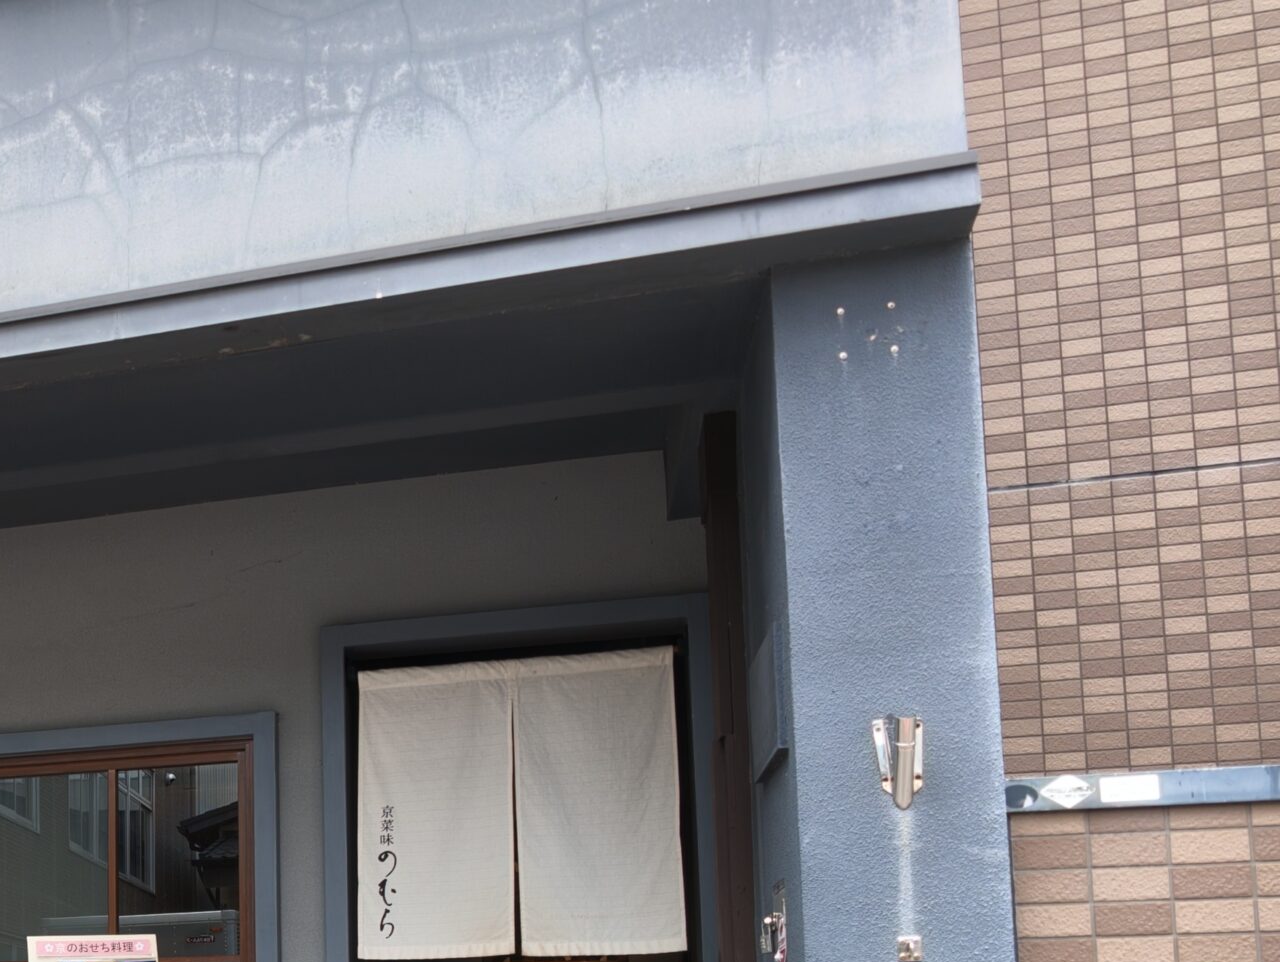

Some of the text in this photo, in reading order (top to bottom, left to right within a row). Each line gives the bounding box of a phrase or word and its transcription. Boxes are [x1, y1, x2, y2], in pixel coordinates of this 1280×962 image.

[377, 805, 397, 939] 京菜味 のむら
[56, 941, 134, 953] 京のおせち料理
